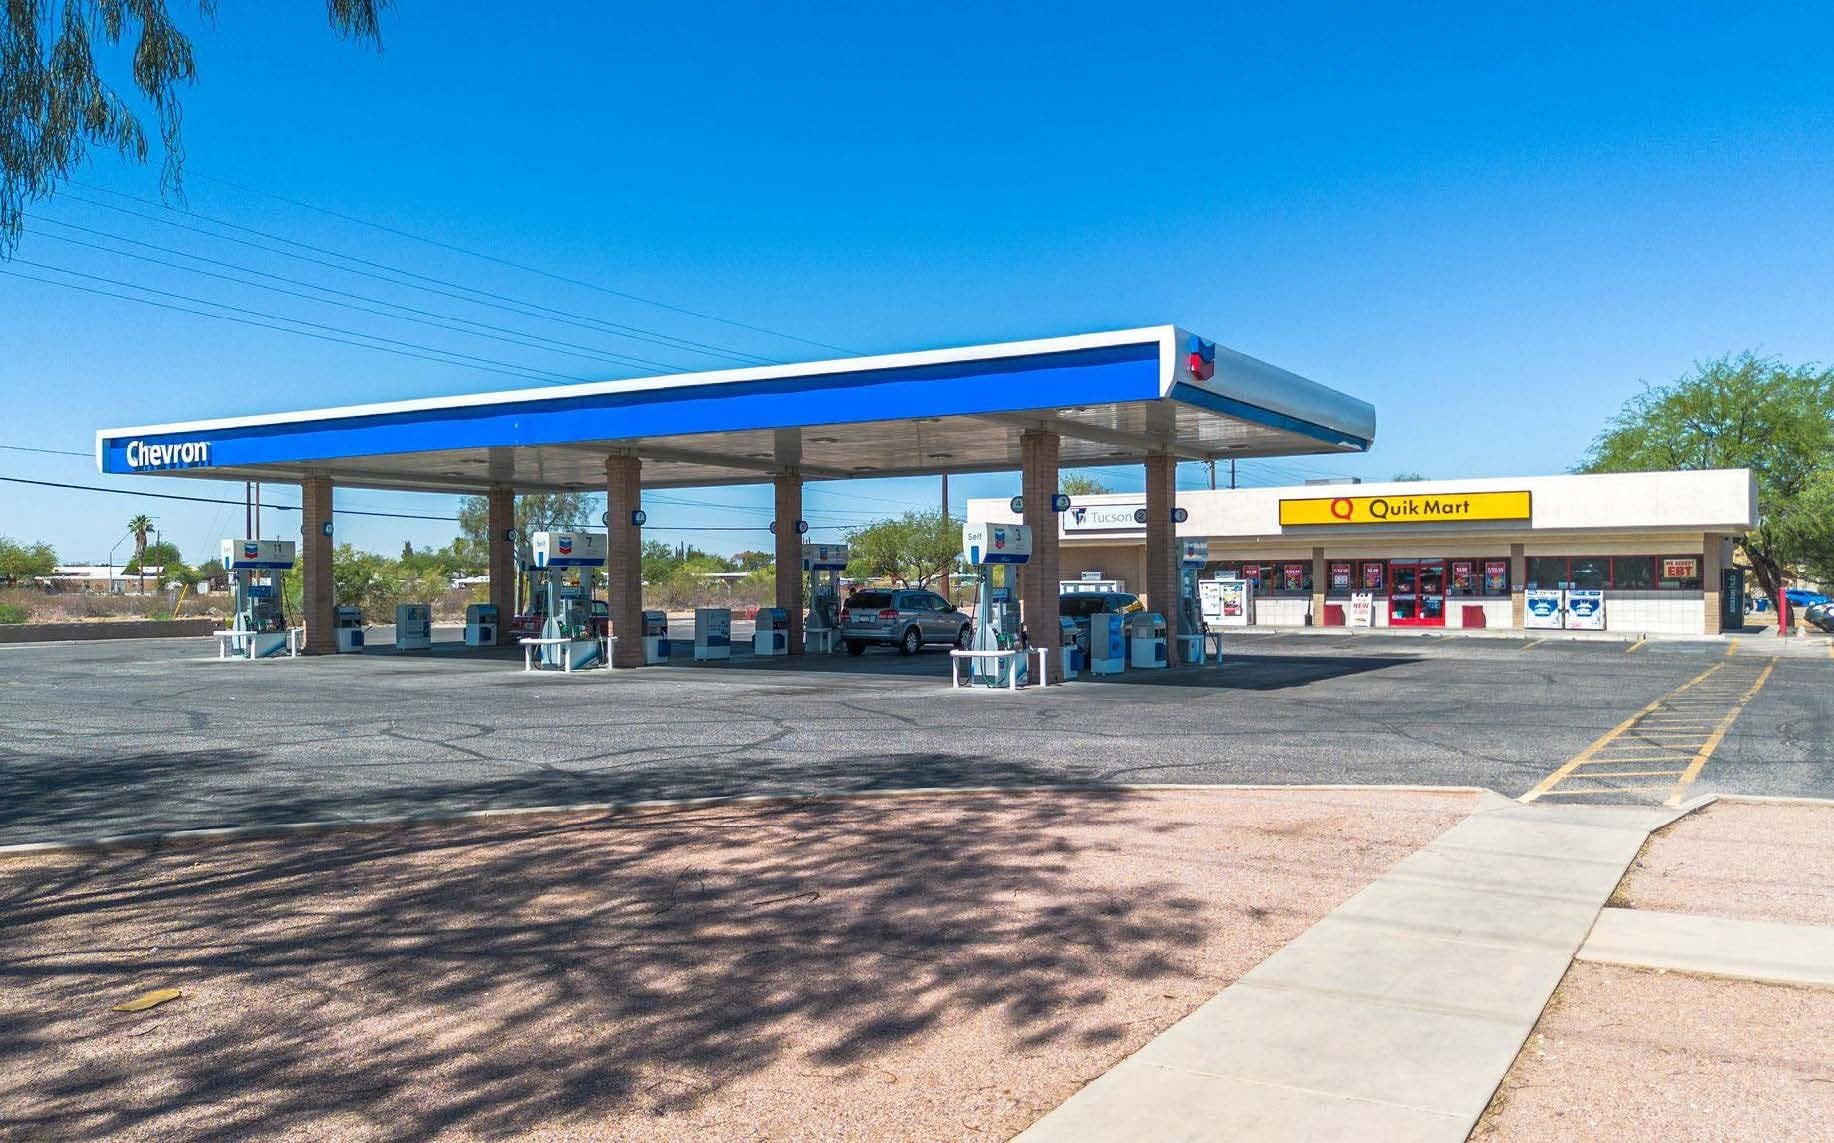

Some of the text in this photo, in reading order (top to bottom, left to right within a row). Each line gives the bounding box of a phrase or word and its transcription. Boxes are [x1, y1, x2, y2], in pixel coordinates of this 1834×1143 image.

[127, 441, 207, 467] Chevron
[1369, 499, 1469, 520] Quik Mart
[1091, 512, 1132, 522] Tucson
[586, 536, 592, 547] 7
[968, 533, 982, 541] Self
[274, 543, 282, 553] 11
[1667, 566, 1692, 576] EBT
